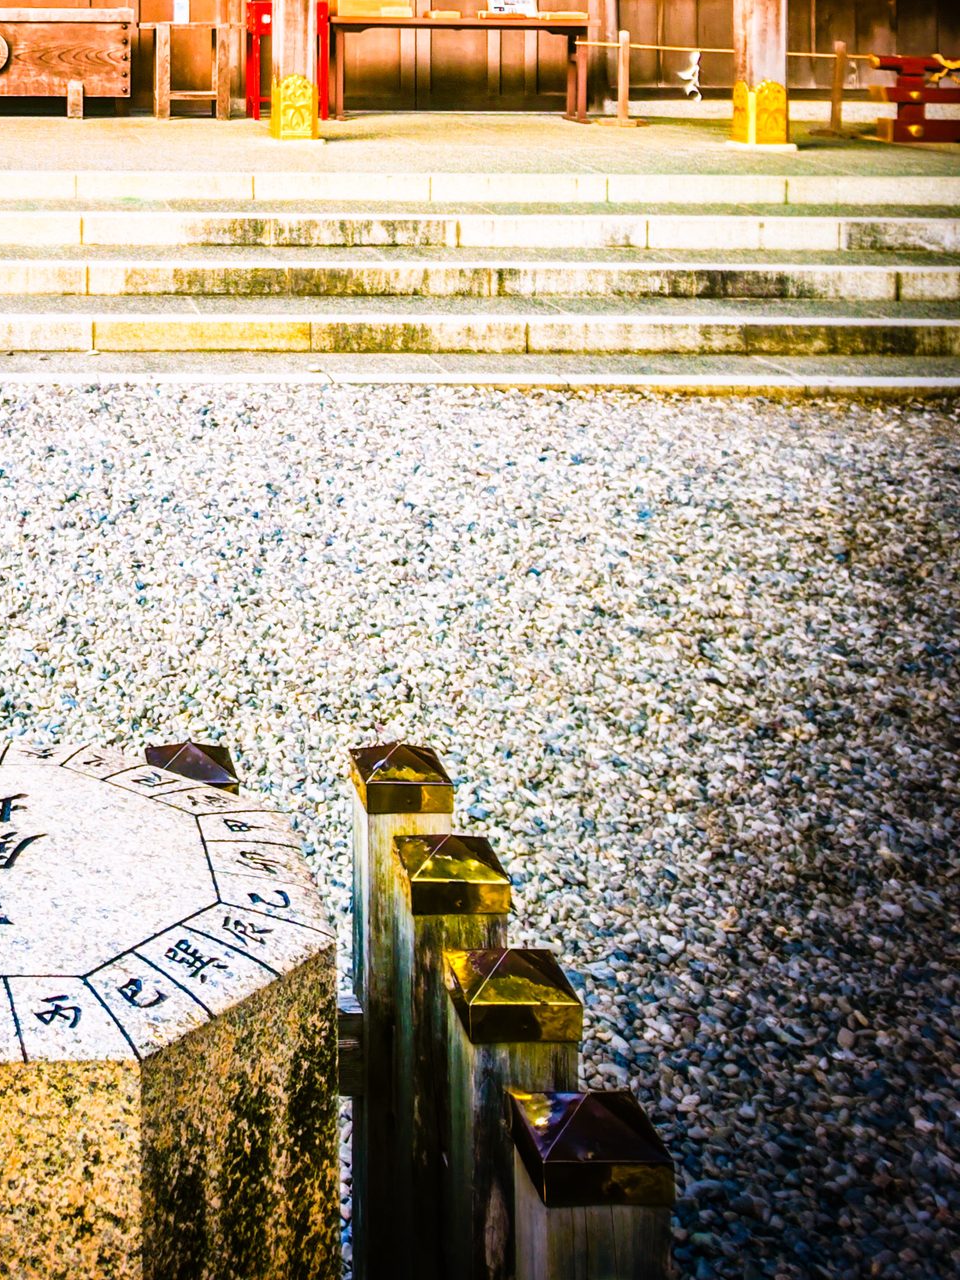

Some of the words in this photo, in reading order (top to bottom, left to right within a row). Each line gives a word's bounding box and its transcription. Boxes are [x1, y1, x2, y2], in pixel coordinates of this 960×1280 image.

[223, 818, 267, 833] 甲
[247, 889, 291, 908] 乙
[222, 915, 274, 946] 辰
[164, 938, 230, 985] 巽
[34, 994, 83, 1029] 丙
